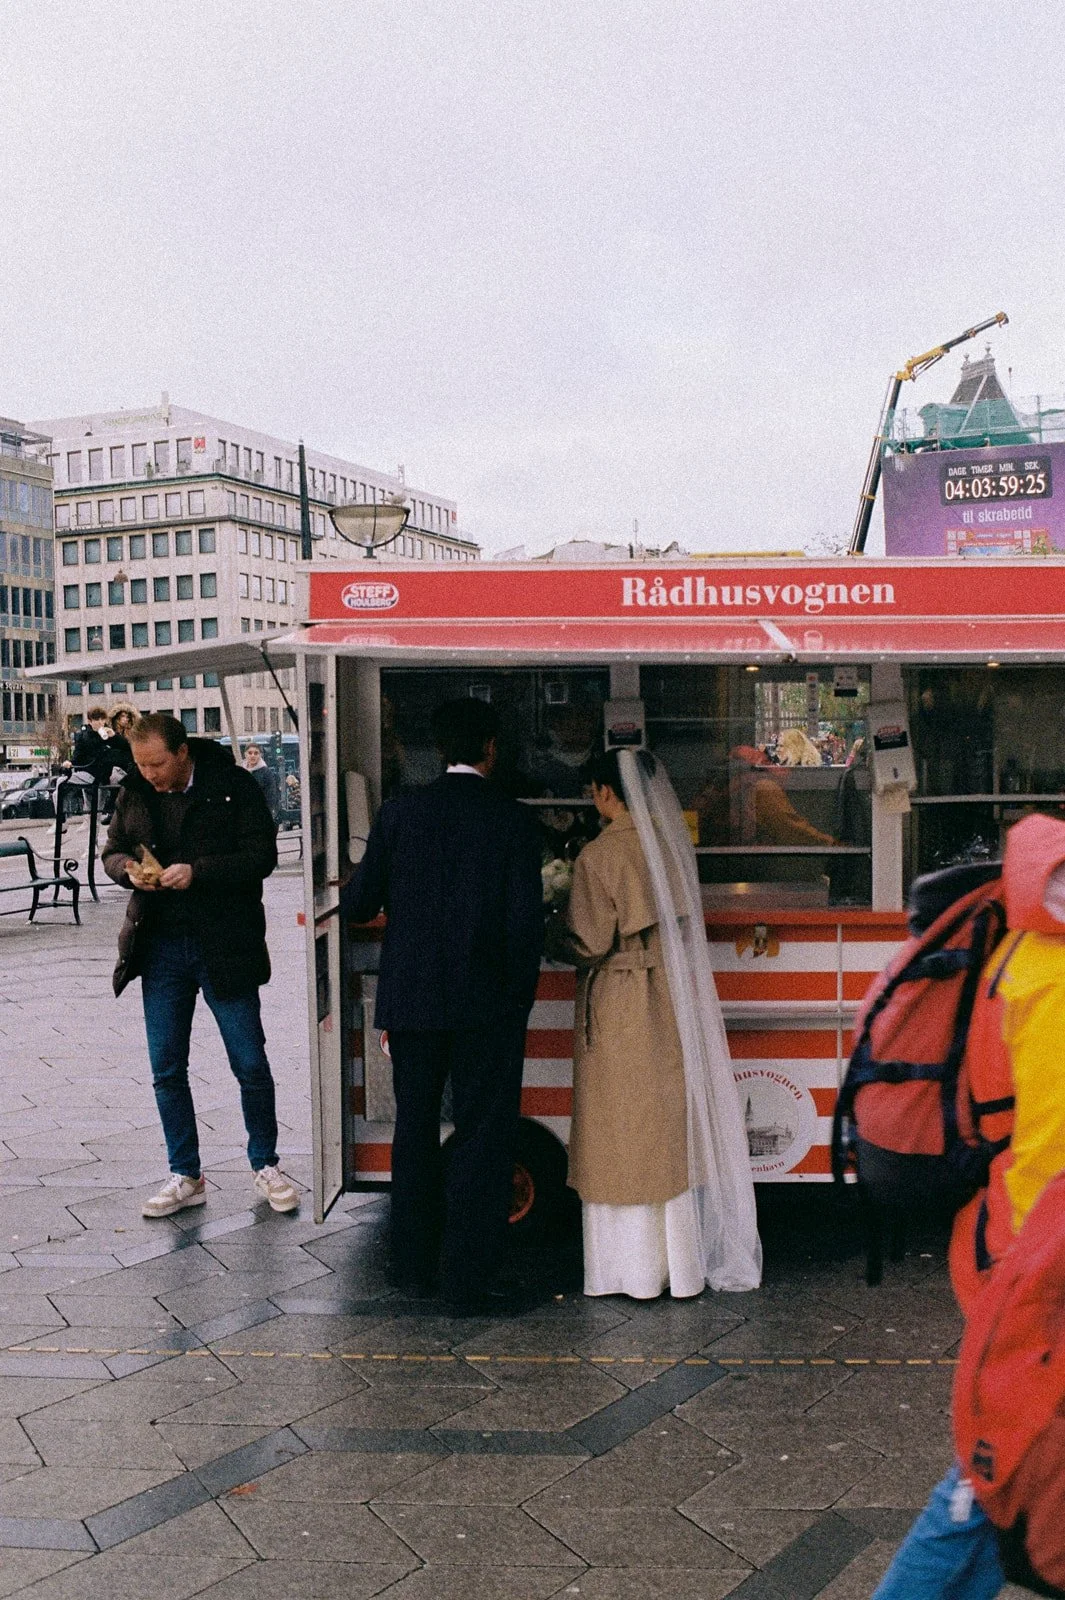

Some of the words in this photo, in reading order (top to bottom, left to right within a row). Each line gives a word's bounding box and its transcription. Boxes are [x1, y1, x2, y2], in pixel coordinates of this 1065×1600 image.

[948, 467, 967, 477] DAGE
[971, 464, 994, 475] TIMER
[945, 473, 1046, 499] 04:03:59:25
[962, 510, 974, 524] til
[978, 506, 1032, 522] skrabetid
[350, 585, 392, 598] STEFF
[621, 576, 896, 613] Rådhusvognen
[733, 1069, 803, 1101] husvognen
[751, 1160, 785, 1173] enhavn
